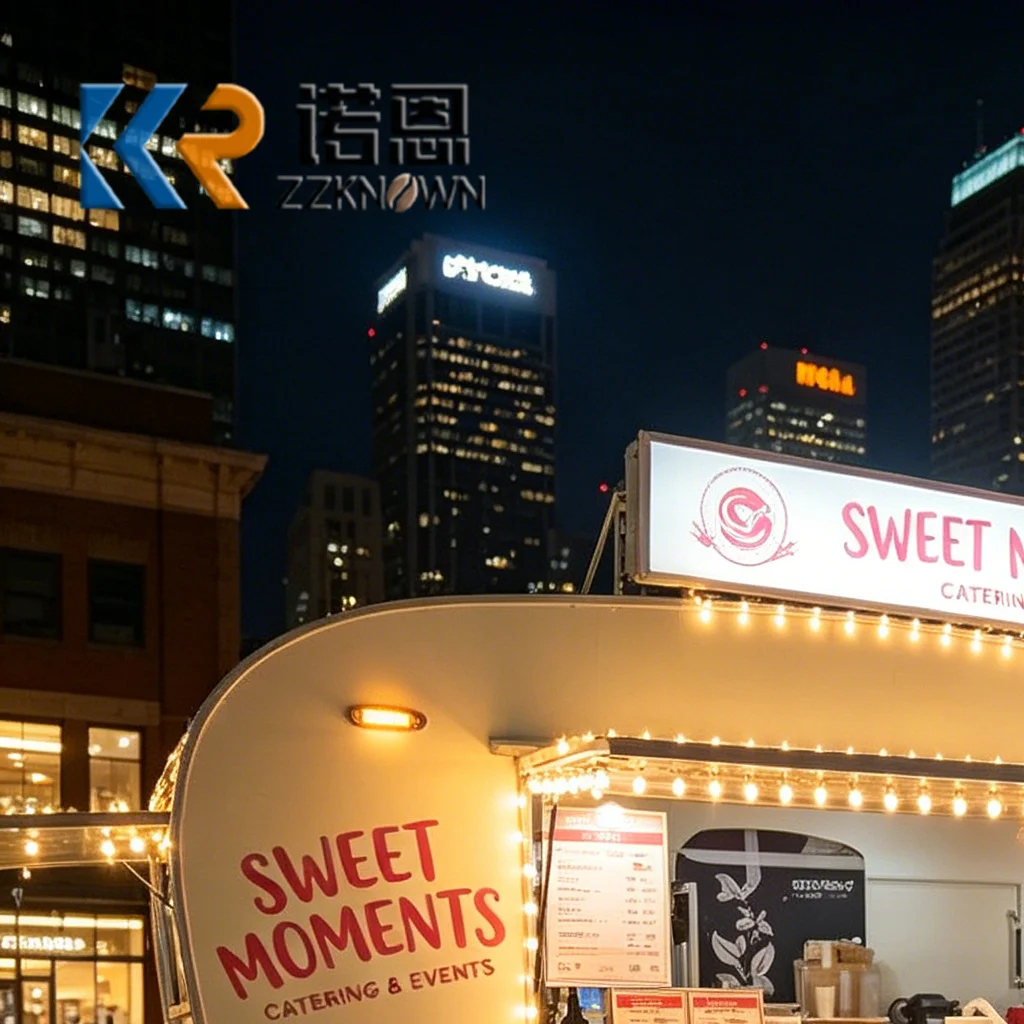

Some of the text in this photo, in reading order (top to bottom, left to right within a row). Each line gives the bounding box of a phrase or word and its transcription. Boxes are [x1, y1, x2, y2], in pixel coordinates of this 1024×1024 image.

[841, 501, 992, 571] SWEET
[240, 819, 440, 915] SWEET
[216, 887, 506, 1000] MOMENTS
[263, 958, 496, 1021] CATERING & EVENTS
